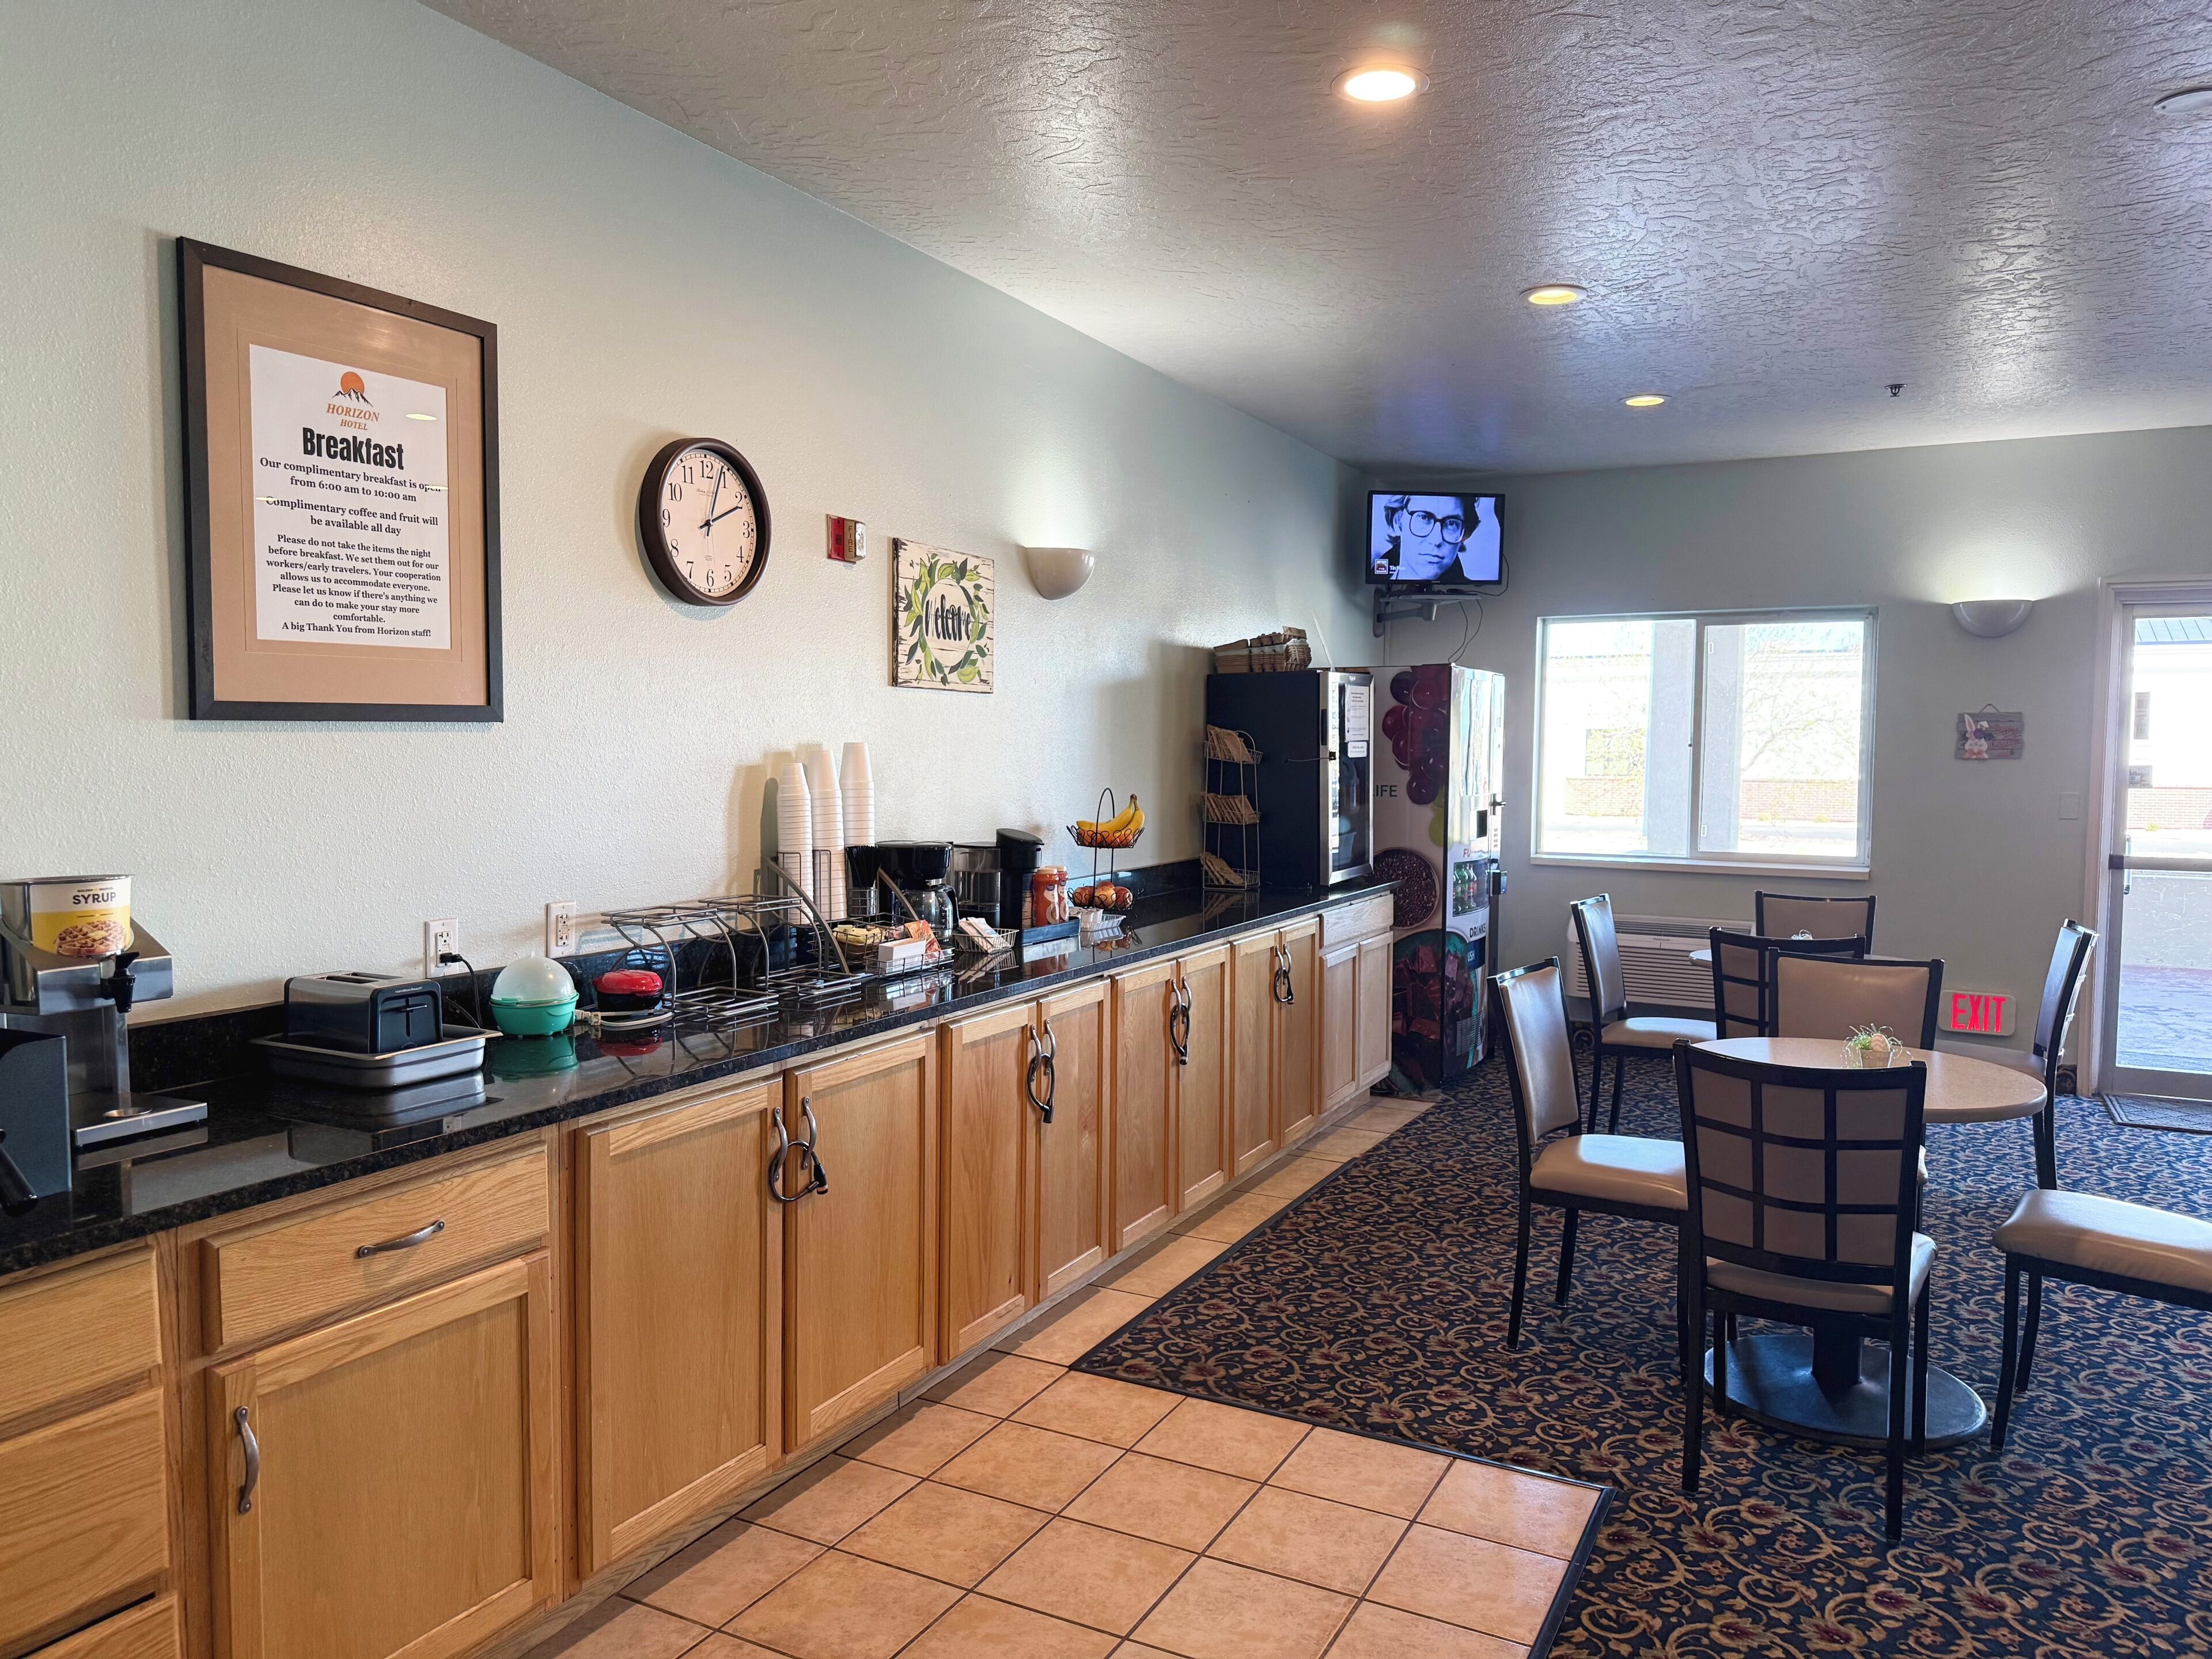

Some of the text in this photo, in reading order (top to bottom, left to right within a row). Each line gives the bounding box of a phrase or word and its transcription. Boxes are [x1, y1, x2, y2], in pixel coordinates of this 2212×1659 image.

[326, 403, 379, 421] HORIZON
[340, 419, 367, 430] HOTEL
[302, 427, 404, 470] Breakfast
[260, 457, 281, 468] Our
[283, 463, 361, 482] complimentary
[363, 472, 407, 487] breakfast
[408, 479, 416, 488] is
[681, 465, 695, 485] 11
[699, 460, 714, 479] 12
[290, 475, 316, 487] from
[318, 480, 342, 491] 6:00
[344, 486, 359, 494] am
[362, 487, 371, 495] to
[374, 490, 400, 499] 10:00
[722, 471, 728, 488] 1
[668, 483, 682, 502] 10
[735, 491, 743, 509] 2
[266, 495, 438, 525] Complimentary coffee and fruit will
[662, 509, 671, 528] 9
[310, 514, 401, 536] be available all day
[743, 521, 750, 539] 3
[277, 534, 306, 544] Please
[308, 537, 319, 546] do
[338, 540, 355, 550] take
[357, 542, 370, 551] the
[372, 544, 394, 554] items
[396, 547, 408, 555] the
[411, 548, 430, 558] night
[670, 539, 679, 558] 8
[736, 546, 744, 563] 4
[268, 545, 297, 556] before
[299, 548, 343, 560] breakfast.
[344, 553, 359, 562] We
[374, 556, 395, 565] them
[412, 559, 423, 568] for
[266, 559, 441, 581] workers/early travelers. Your cooperation
[686, 561, 694, 579] 7
[706, 569, 714, 587] 6
[724, 565, 732, 582] 5
[280, 571, 308, 581] allows
[334, 578, 391, 588] accommodate
[392, 583, 430, 592] everyone.
[272, 584, 301, 593] Please
[303, 585, 314, 594] let
[328, 587, 351, 597] know
[354, 589, 361, 597] if
[361, 590, 389, 600] there's
[391, 593, 425, 604] anything
[312, 599, 323, 607] do
[336, 601, 358, 609] make
[381, 605, 397, 613] stay
[333, 613, 385, 622] comfortable.
[925, 594, 972, 641] Welcome
[290, 621, 305, 632] big
[306, 623, 334, 631] Thank
[335, 624, 353, 632] You
[354, 625, 374, 634] from
[377, 627, 409, 635] Horizon
[1373, 785, 1397, 797] IFE
[73, 892, 116, 904] SYRUP
[1469, 923, 1486, 938] DRINKS
[1467, 949, 1475, 963] USH
[1950, 993, 2007, 1033] EXIT
